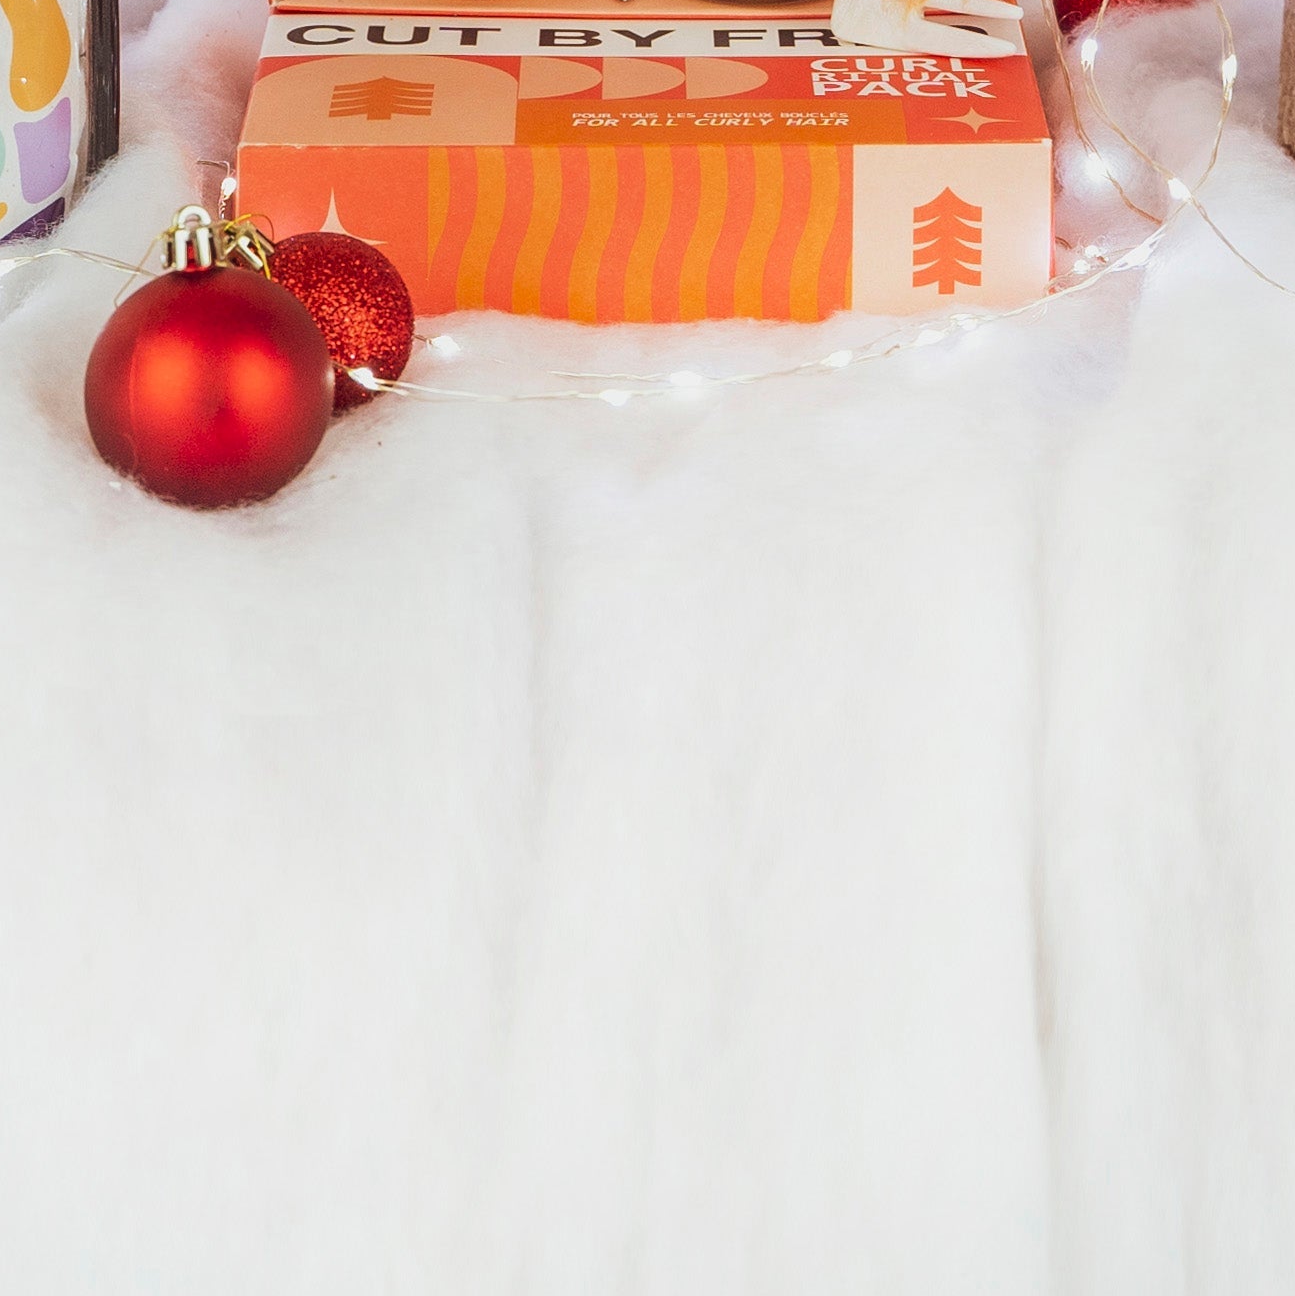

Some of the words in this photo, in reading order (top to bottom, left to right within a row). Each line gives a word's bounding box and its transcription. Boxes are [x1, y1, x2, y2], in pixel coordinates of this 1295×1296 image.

[286, 24, 502, 46] CUT
[538, 28, 676, 48] BY
[810, 58, 986, 72] CURL
[811, 71, 990, 83] RITUAL
[812, 81, 997, 99] PACK
[572, 118, 621, 127] FOR
[631, 118, 678, 127] ALL
[693, 118, 773, 127] CURLY
[785, 118, 850, 127] HAIR
